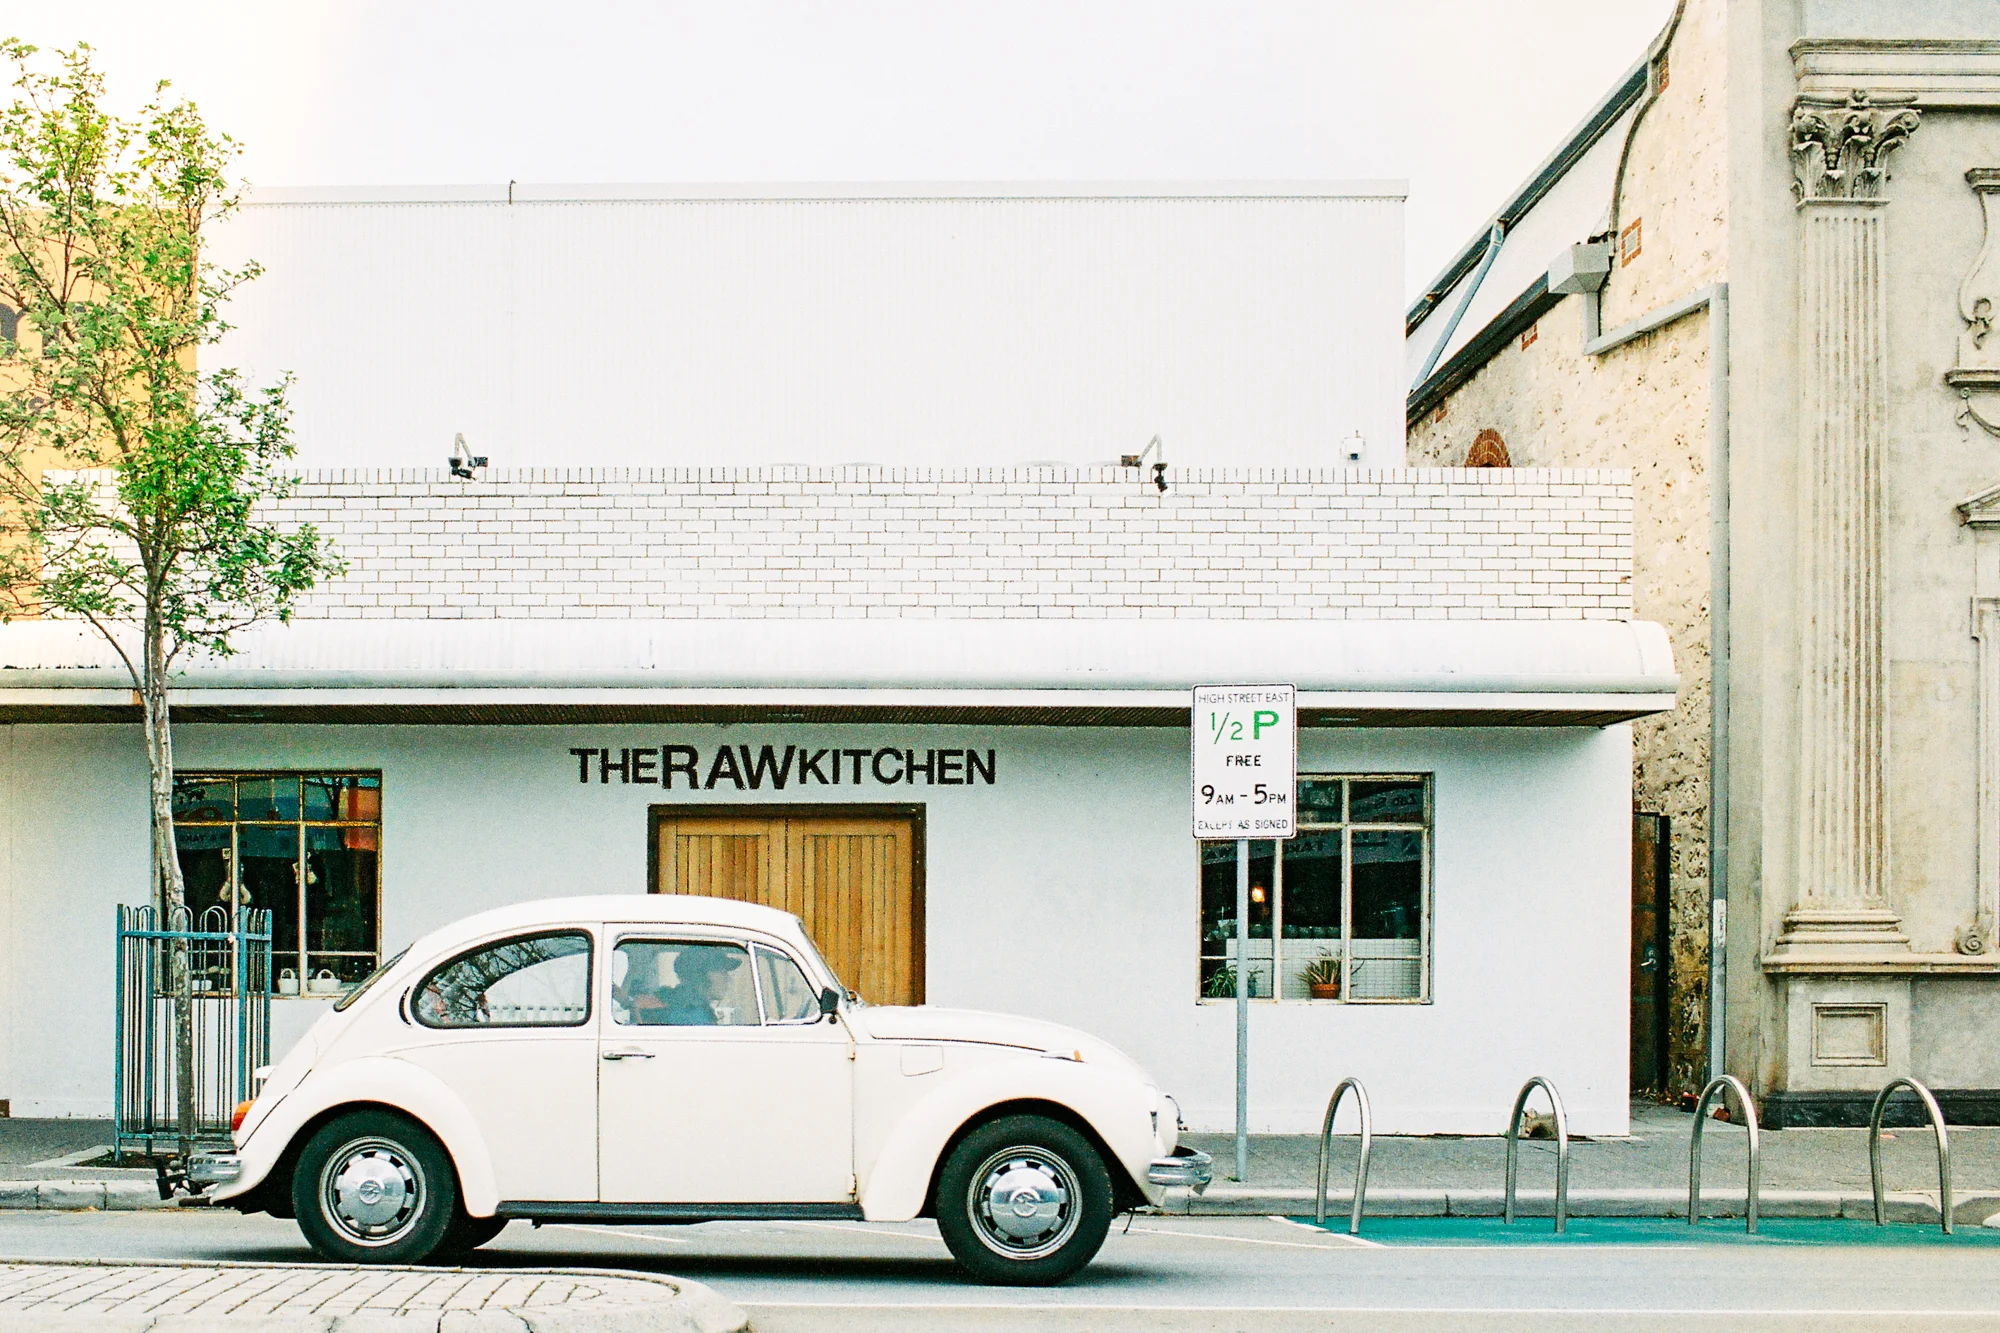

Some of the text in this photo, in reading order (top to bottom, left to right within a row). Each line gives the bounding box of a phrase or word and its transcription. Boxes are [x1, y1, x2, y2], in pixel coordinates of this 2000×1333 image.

[1198, 692, 1290, 704] HIGH STREET EAST
[1253, 710, 1280, 741] P
[1225, 755, 1262, 767] FREE
[1238, 819, 1250, 830] AS
[1255, 819, 1289, 830] SIGNED
